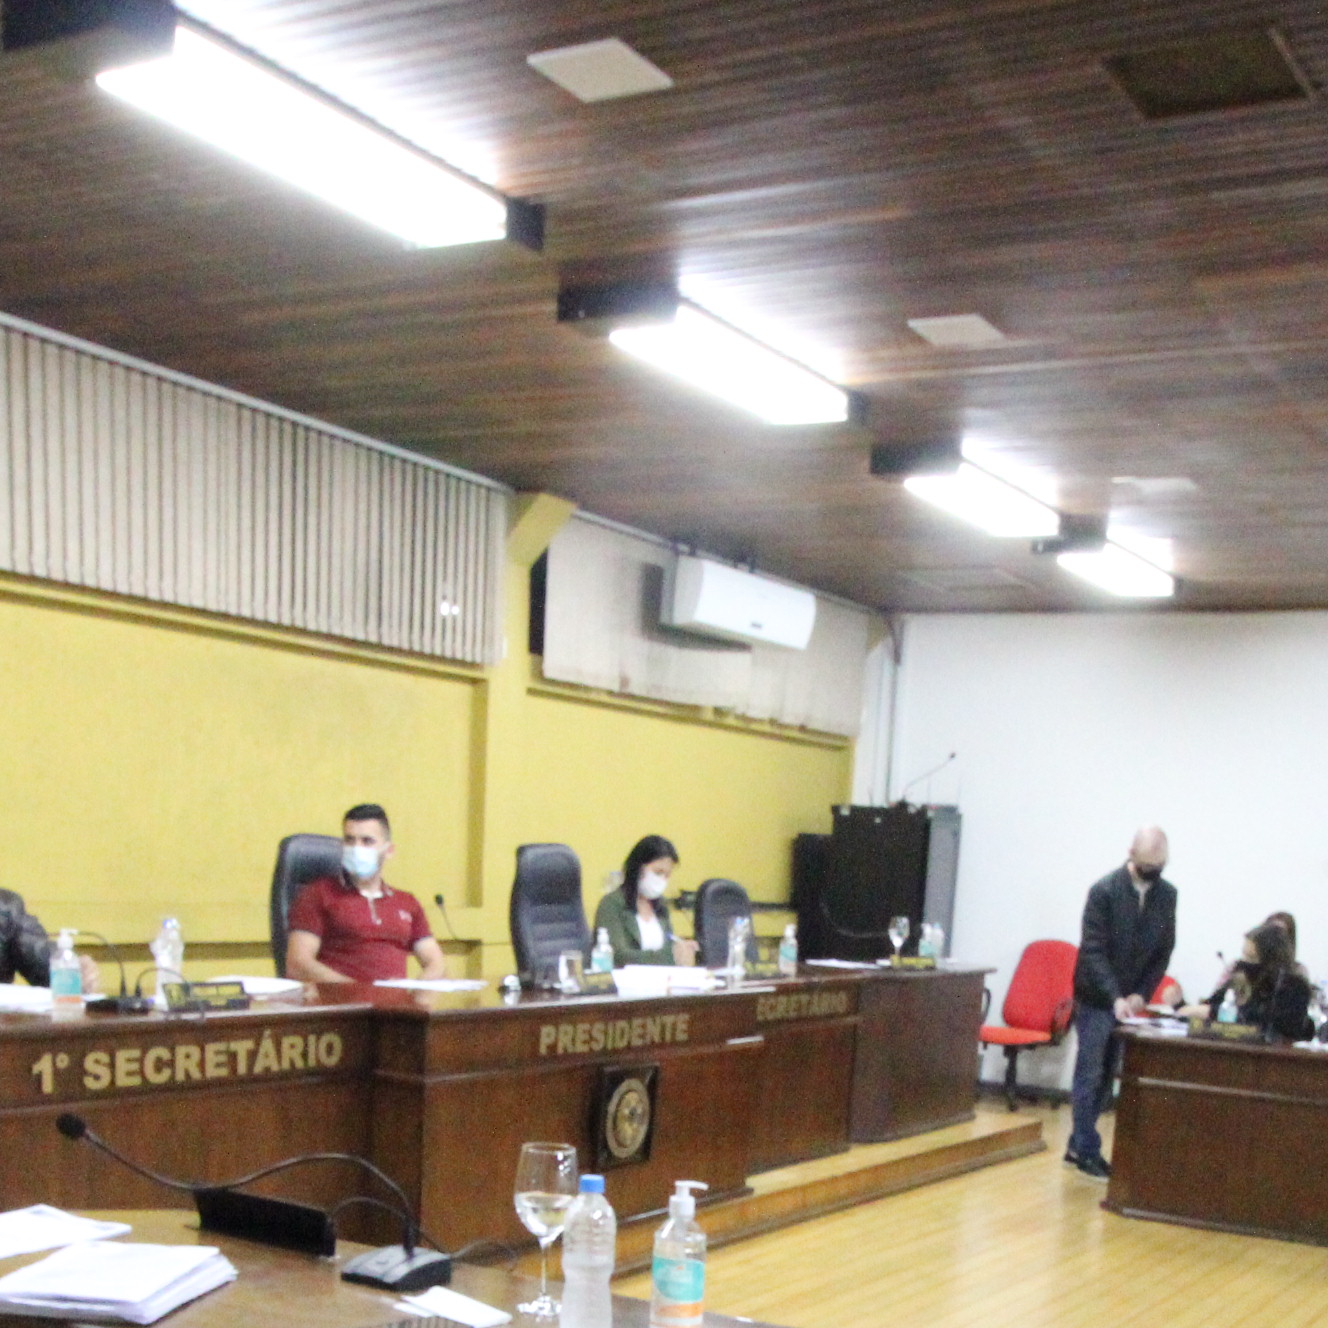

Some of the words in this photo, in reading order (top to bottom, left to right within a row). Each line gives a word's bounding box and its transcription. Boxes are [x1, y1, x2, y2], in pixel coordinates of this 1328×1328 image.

[756, 988, 848, 1021] ECRETÁRIO
[539, 1013, 690, 1055] PRESIDENTE
[83, 1028, 343, 1090] SECRETÁRIO
